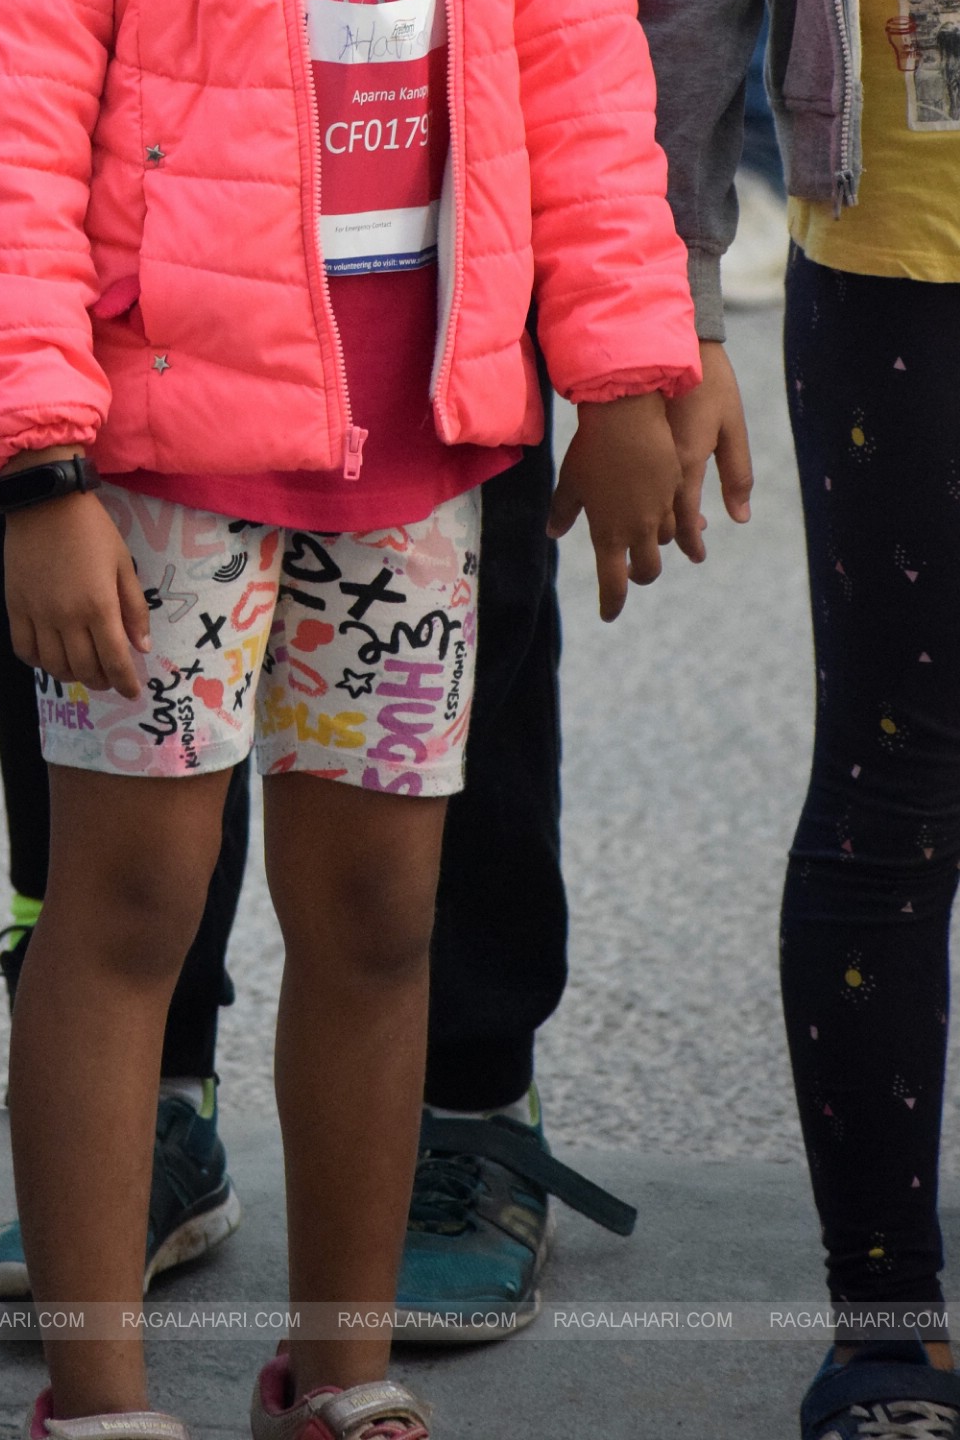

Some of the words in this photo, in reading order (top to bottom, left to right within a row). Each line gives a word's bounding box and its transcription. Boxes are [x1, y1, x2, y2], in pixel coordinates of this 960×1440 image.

[352, 89, 396, 106] Aparna
[334, 259, 372, 271] volunteering
[373, 259, 382, 268] do
[383, 258, 398, 267] visit:
